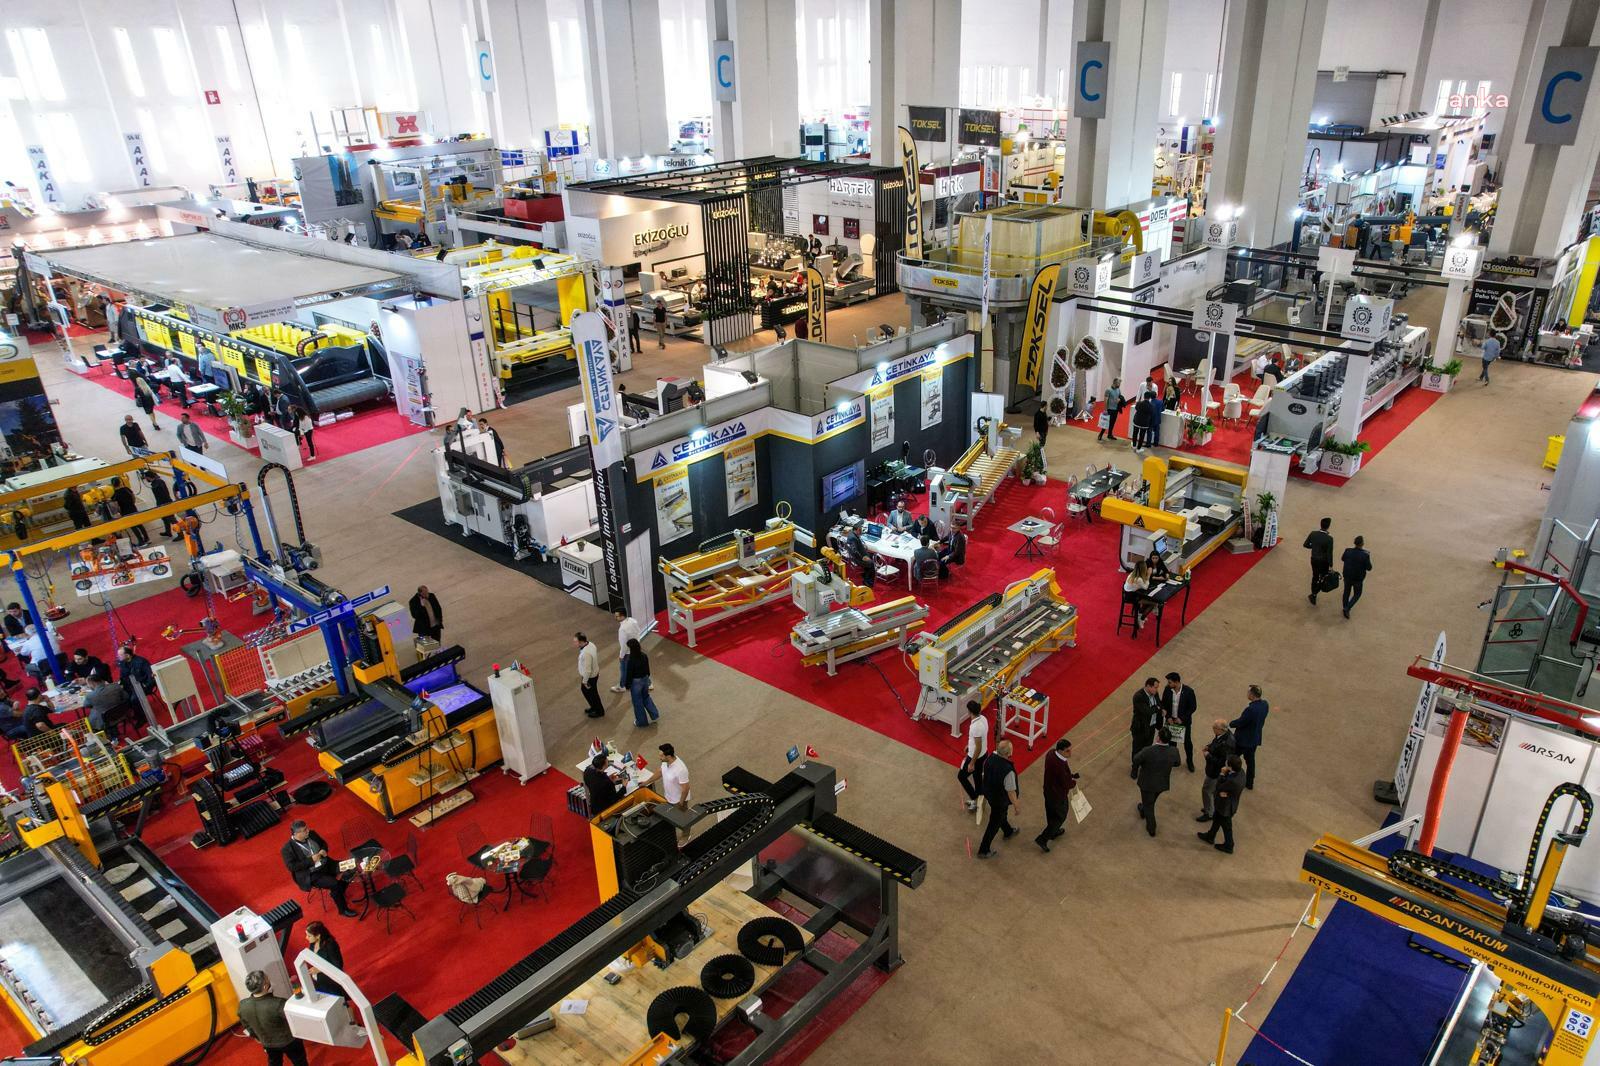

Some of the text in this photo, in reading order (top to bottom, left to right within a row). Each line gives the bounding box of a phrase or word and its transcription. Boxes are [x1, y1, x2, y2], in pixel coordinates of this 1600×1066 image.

[480, 52, 492, 80] C
[717, 54, 732, 88] C
[1079, 60, 1103, 102] C
[1541, 70, 1583, 124] C
[911, 119, 941, 129] TOKSEL
[964, 123, 997, 134] TOKSEL
[133, 146, 150, 187] AKAL
[37, 160, 57, 203] AKAL
[634, 223, 690, 246] EKİZOĞLU
[933, 277, 958, 288] TOKSEL
[1448, 266, 1467, 274] GMS
[1073, 282, 1089, 291] GMS
[228, 322, 247, 331] MKS
[618, 312, 628, 358] DEMMAK
[1026, 278, 1053, 382] TOKSEL
[1204, 320, 1223, 329] GMS
[1349, 324, 1370, 334] GMS
[606, 540, 618, 591] Leading
[1525, 744, 1576, 765] ARSAN
[1308, 876, 1358, 903] RTS 250
[1396, 898, 1509, 952] ARSAN VAKUM
[1463, 945, 1592, 1008] www.arsanhidrolik.com
